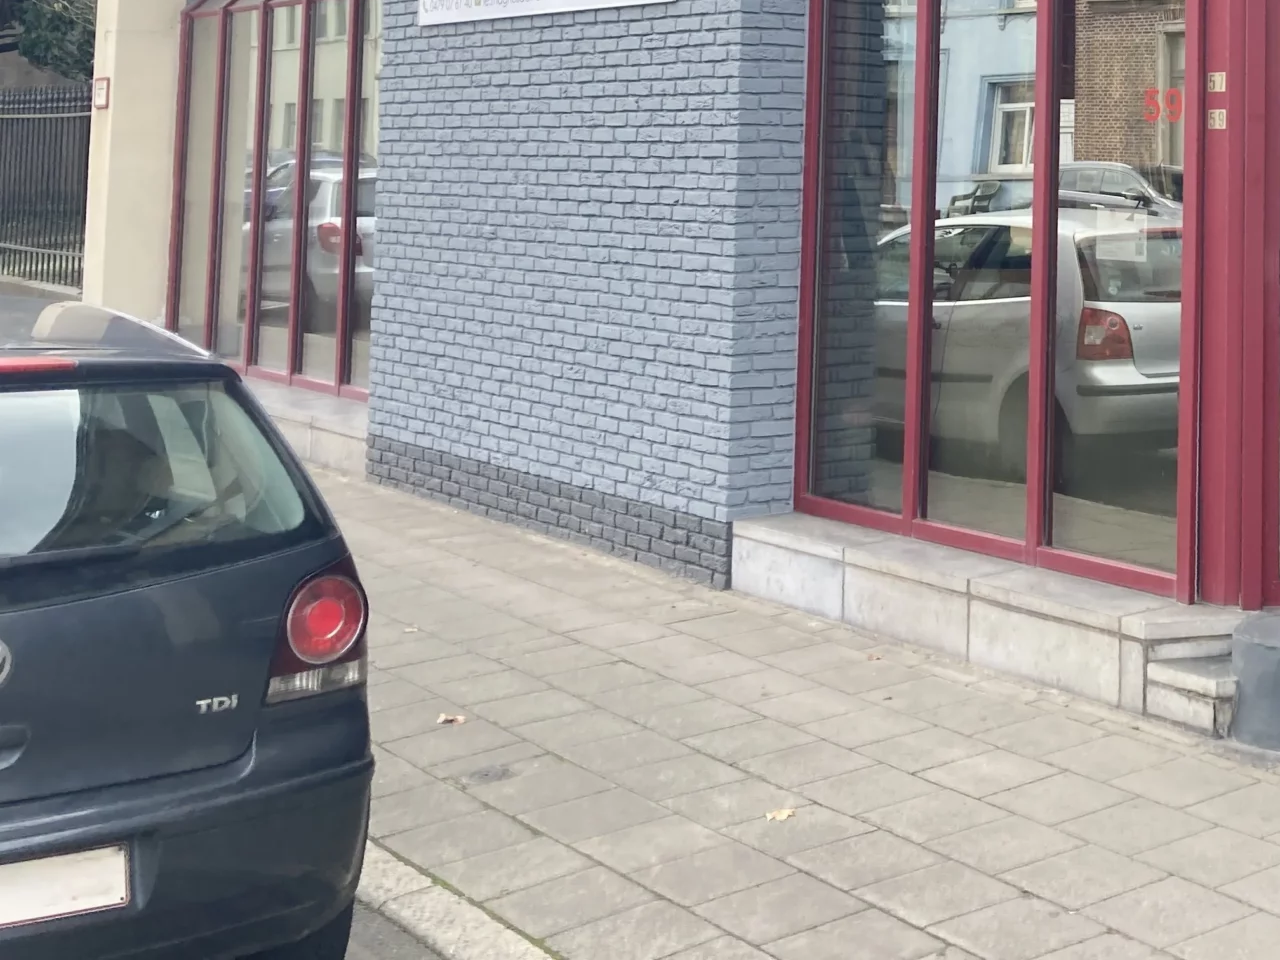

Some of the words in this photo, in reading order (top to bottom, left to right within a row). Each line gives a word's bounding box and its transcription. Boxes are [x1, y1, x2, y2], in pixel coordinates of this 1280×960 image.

[1209, 74, 1224, 90] 57
[1144, 88, 1182, 123] 59
[1209, 111, 1224, 128] 59
